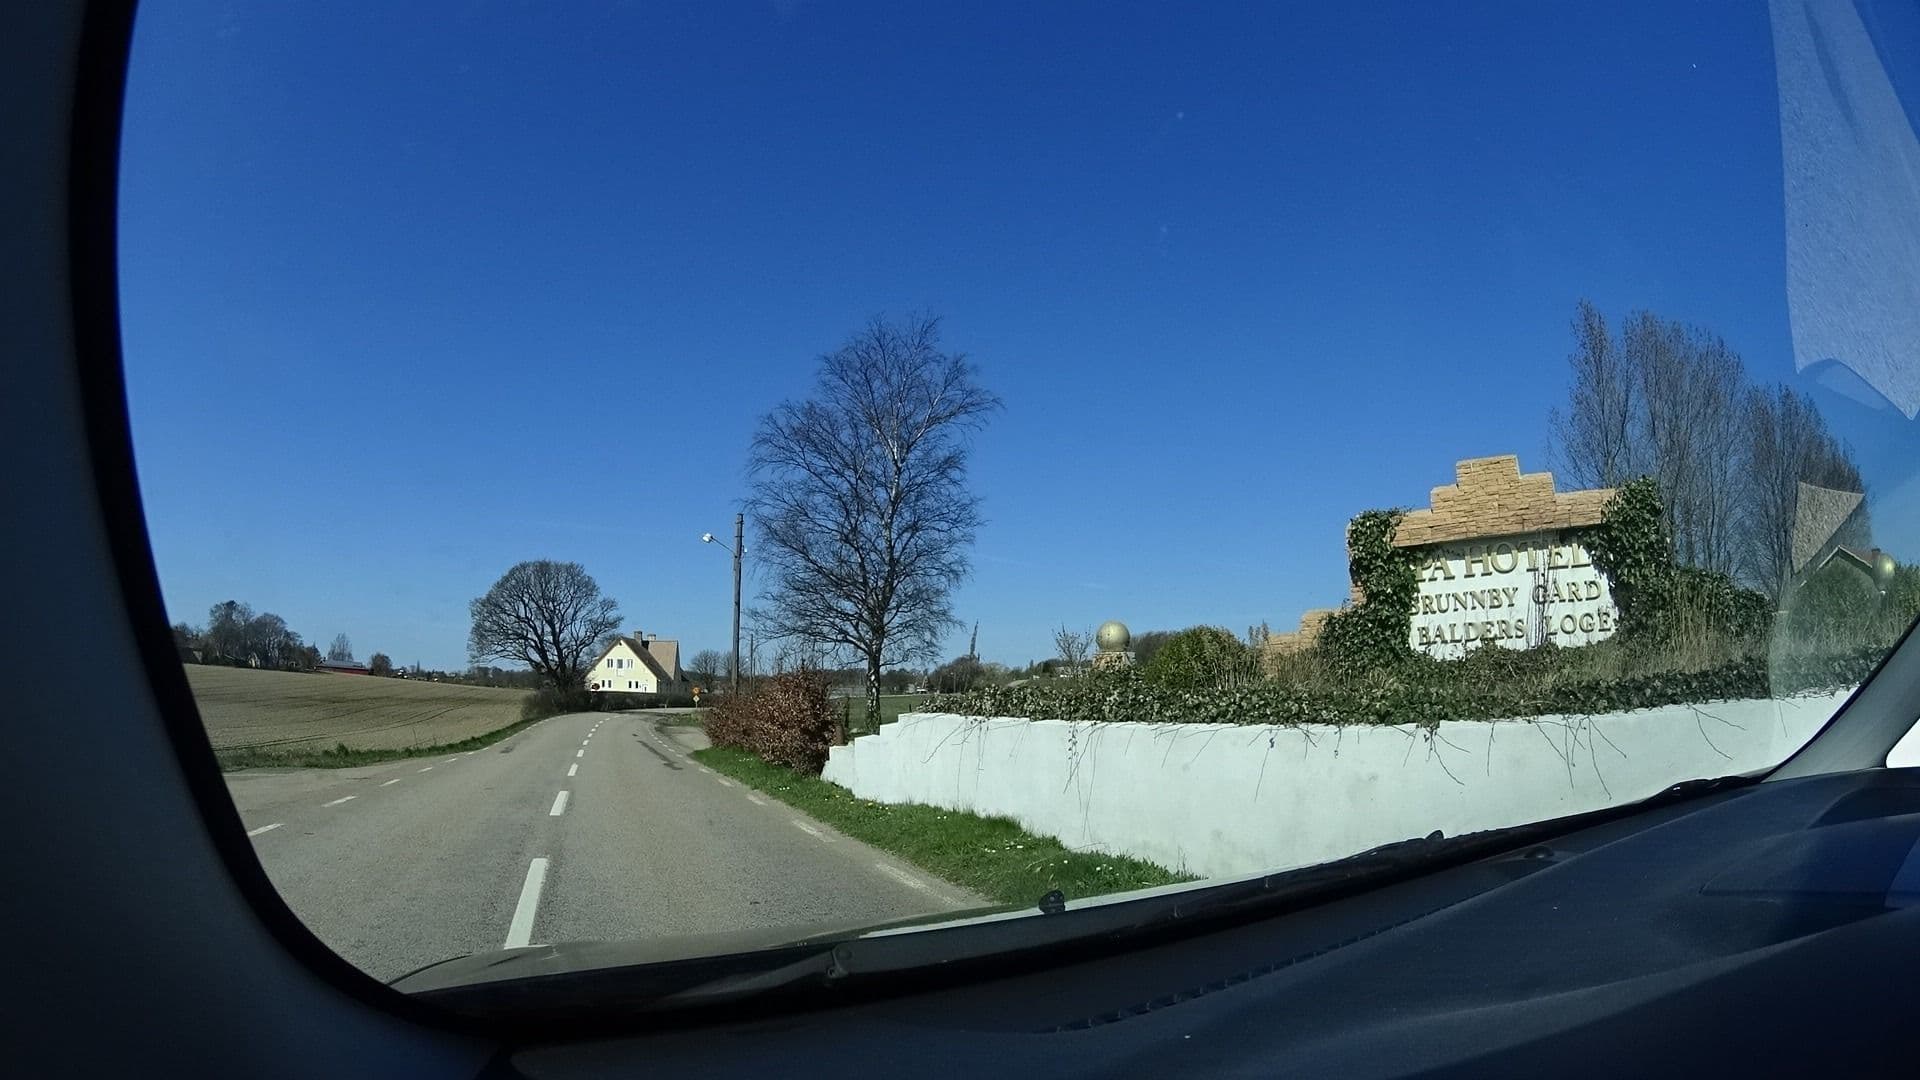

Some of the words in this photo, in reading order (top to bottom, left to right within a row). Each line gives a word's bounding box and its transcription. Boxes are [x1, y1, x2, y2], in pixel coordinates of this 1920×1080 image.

[1464, 537, 1591, 578] HOTEL
[1408, 587, 1518, 615] BRUNNBY
[1417, 619, 1526, 645] BALDERS
